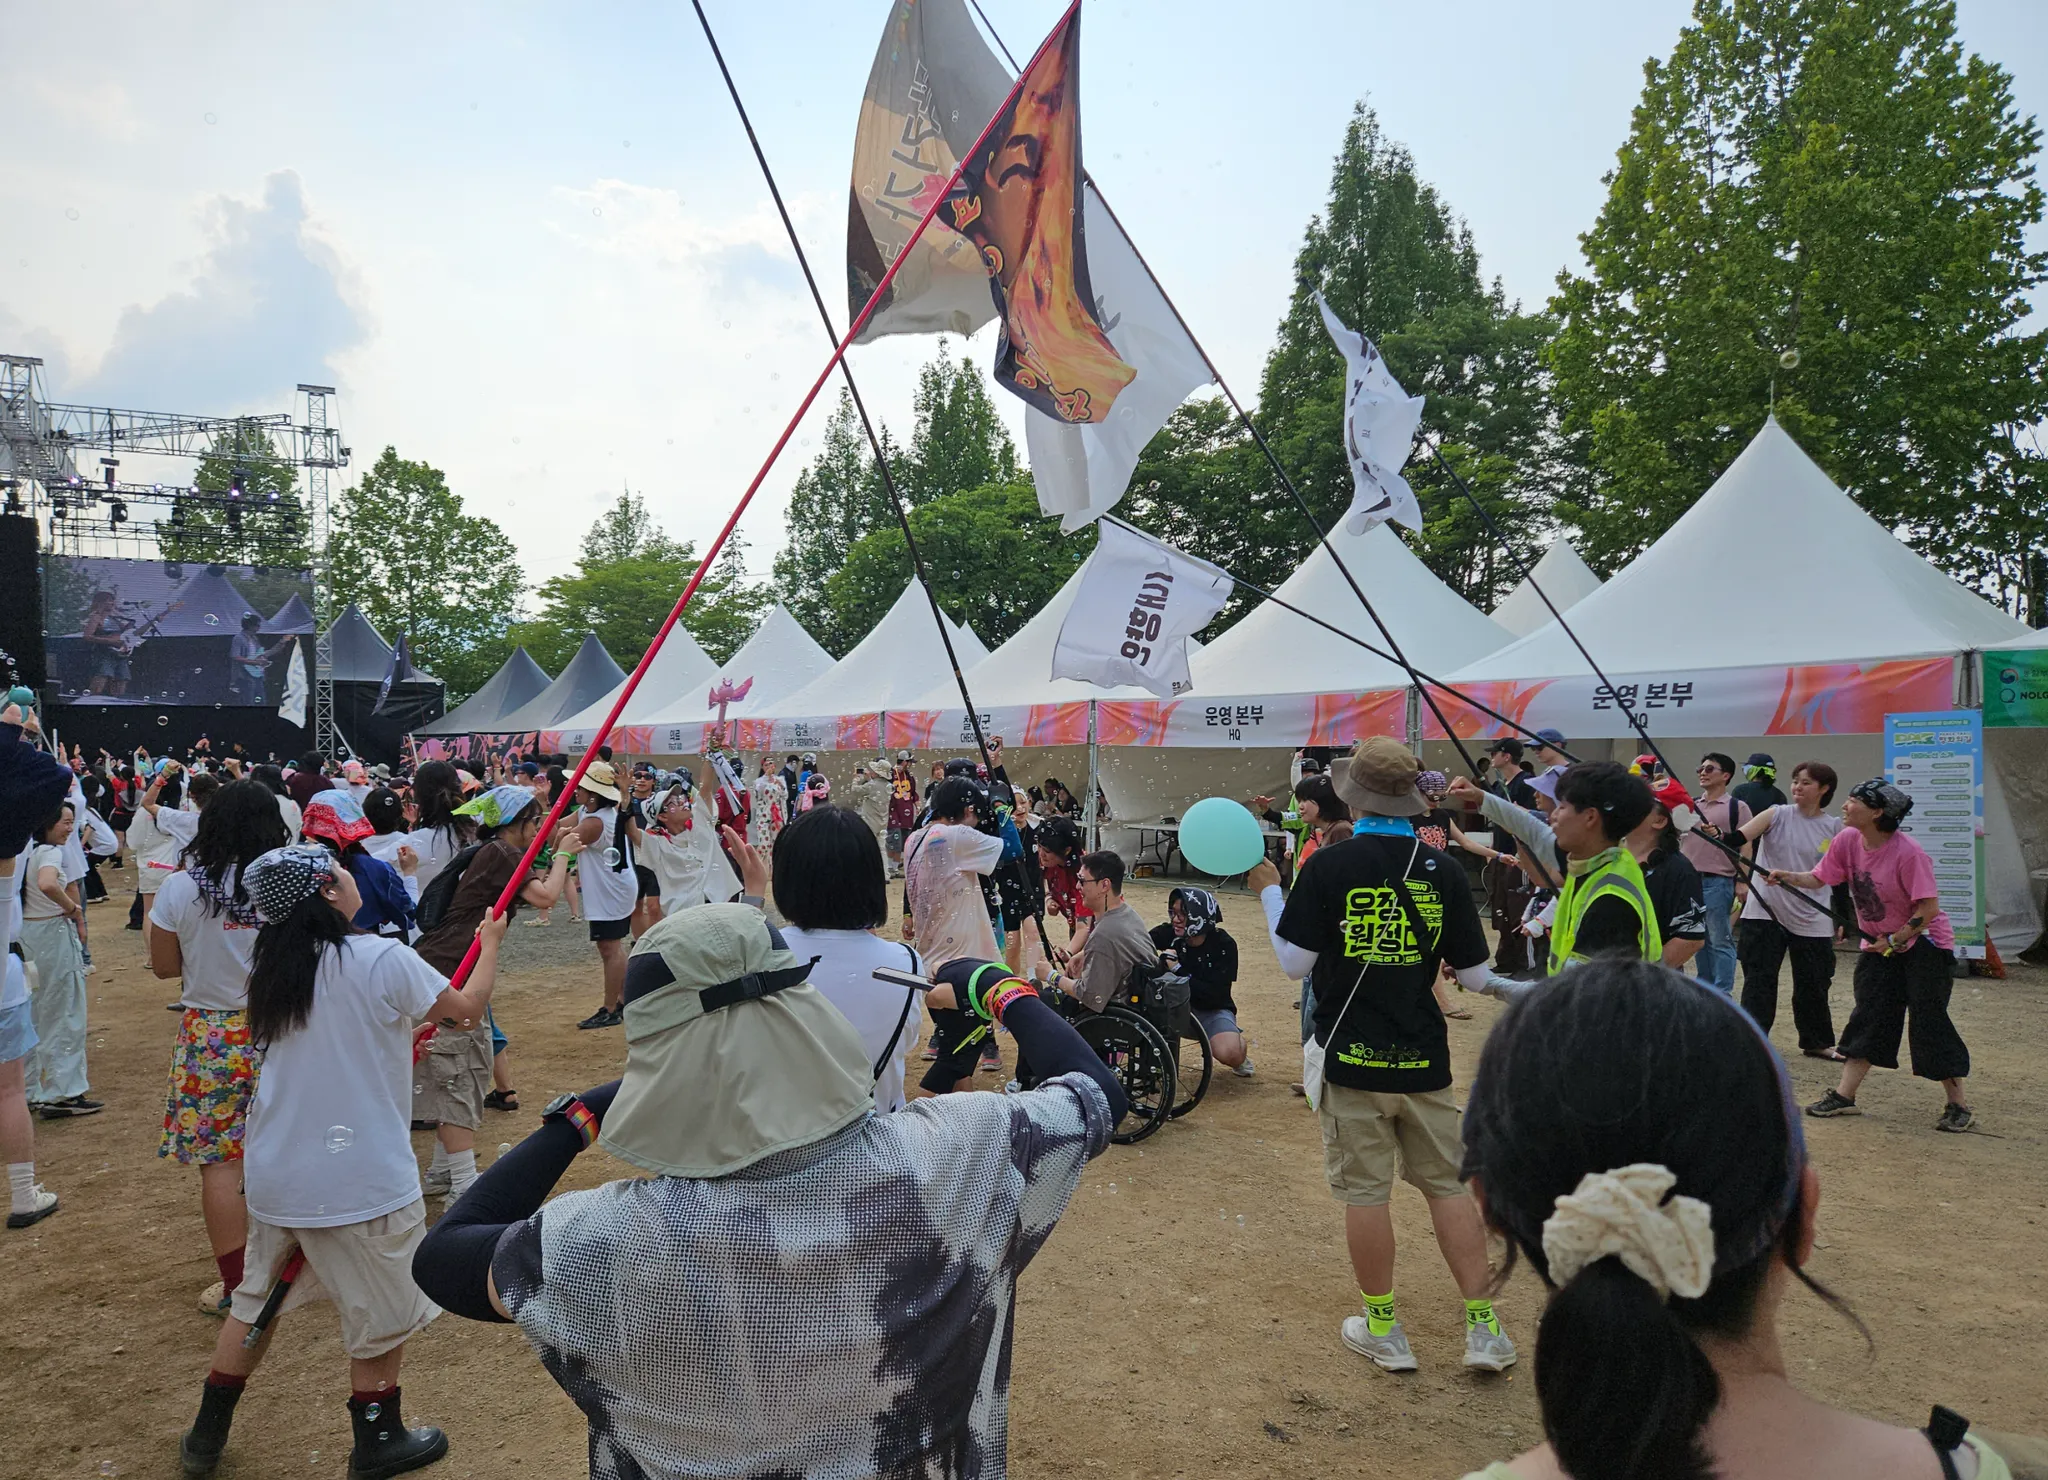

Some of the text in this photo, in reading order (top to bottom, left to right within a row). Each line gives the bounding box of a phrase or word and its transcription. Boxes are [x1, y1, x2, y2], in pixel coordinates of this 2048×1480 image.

[1592, 682, 1693, 710] 운영 본부
[1205, 705, 1264, 726] 운영 본부
[1228, 728, 1241, 741] HQ
[1348, 890, 1404, 922] 우정
[223, 921, 238, 930] be
[998, 988, 1024, 1005] FESTIVAL
